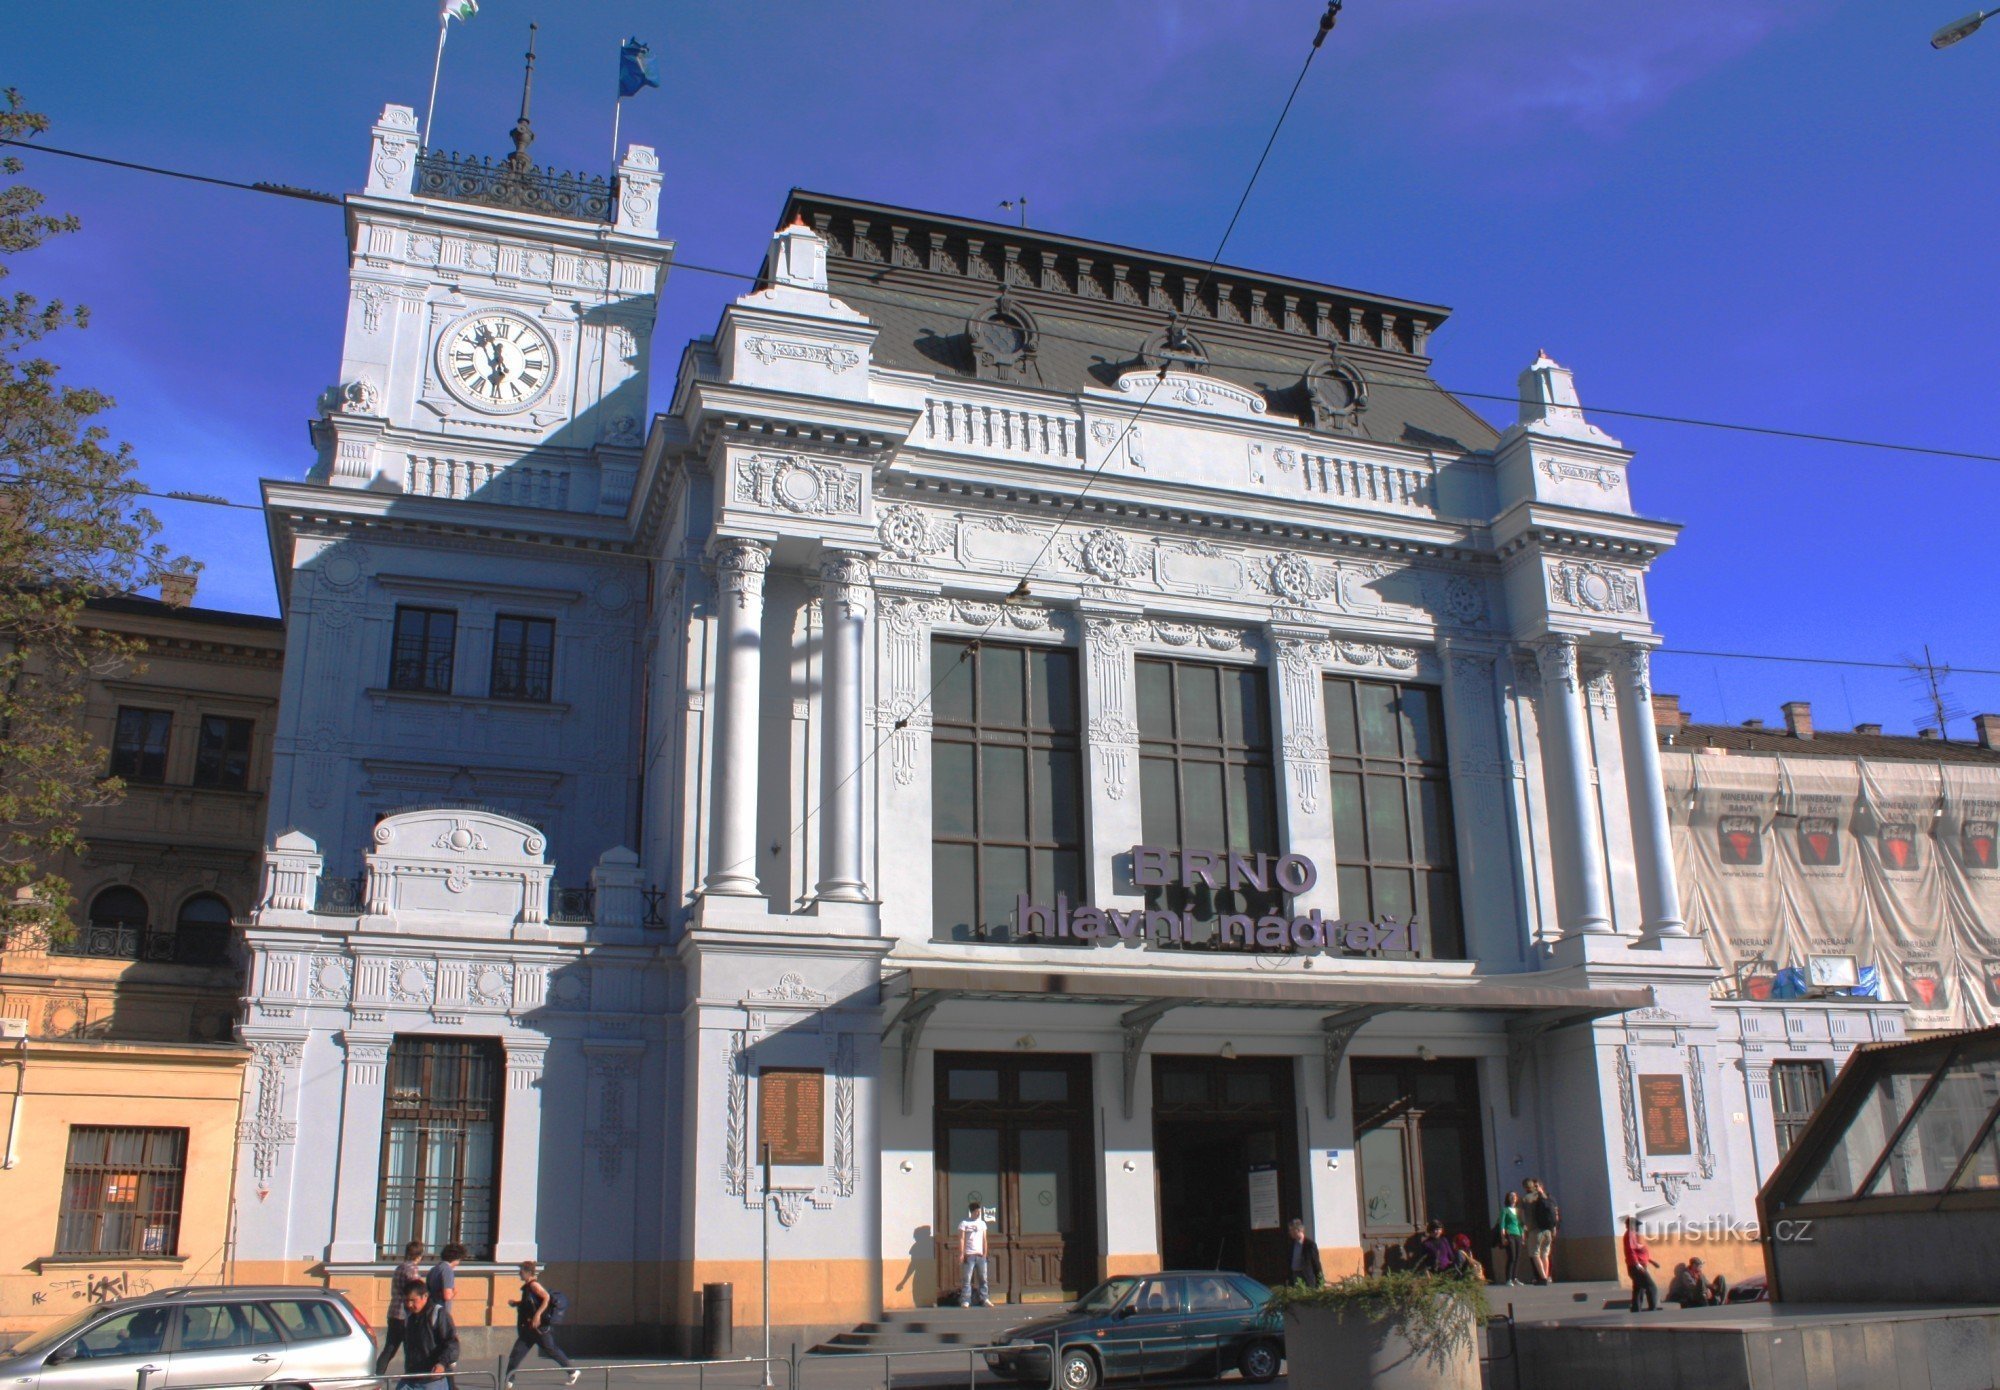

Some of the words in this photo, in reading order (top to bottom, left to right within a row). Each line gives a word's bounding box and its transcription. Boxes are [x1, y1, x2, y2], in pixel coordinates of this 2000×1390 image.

[1728, 804, 1753, 812] BARVY
[1133, 844, 1318, 894] BRNO
[1017, 892, 1195, 942] hlavní
[1220, 907, 1419, 952] nádraží
